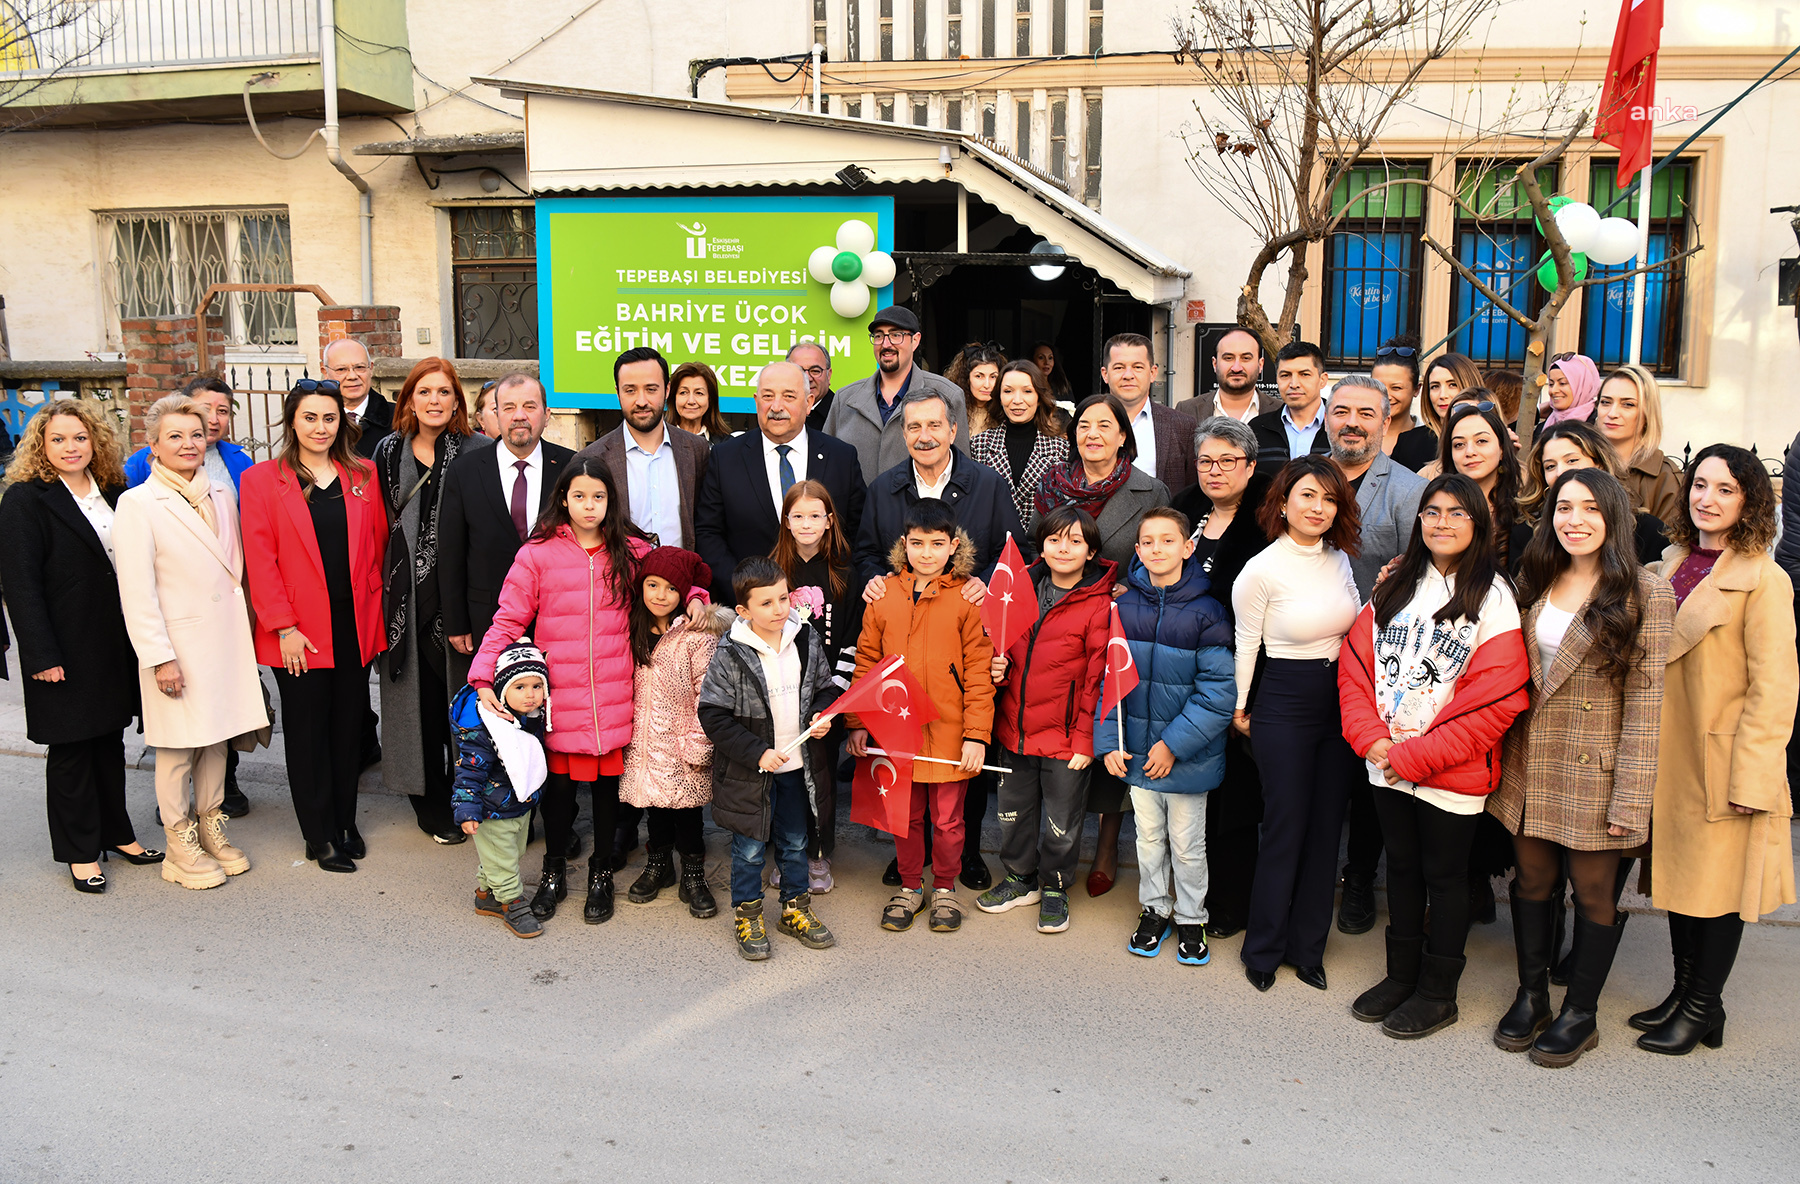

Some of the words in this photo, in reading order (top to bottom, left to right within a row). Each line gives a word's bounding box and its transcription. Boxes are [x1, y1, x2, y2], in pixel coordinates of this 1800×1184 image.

[707, 243, 744, 253] TEPEBAŞI
[615, 269, 698, 286] TEPEBAŞI
[704, 267, 807, 284] BELEDİYESİ
[616, 300, 726, 323] BAHRİYE
[735, 300, 808, 327] ÜÇOK
[575, 325, 673, 354] EĞİTİM
[682, 332, 721, 354] VE
